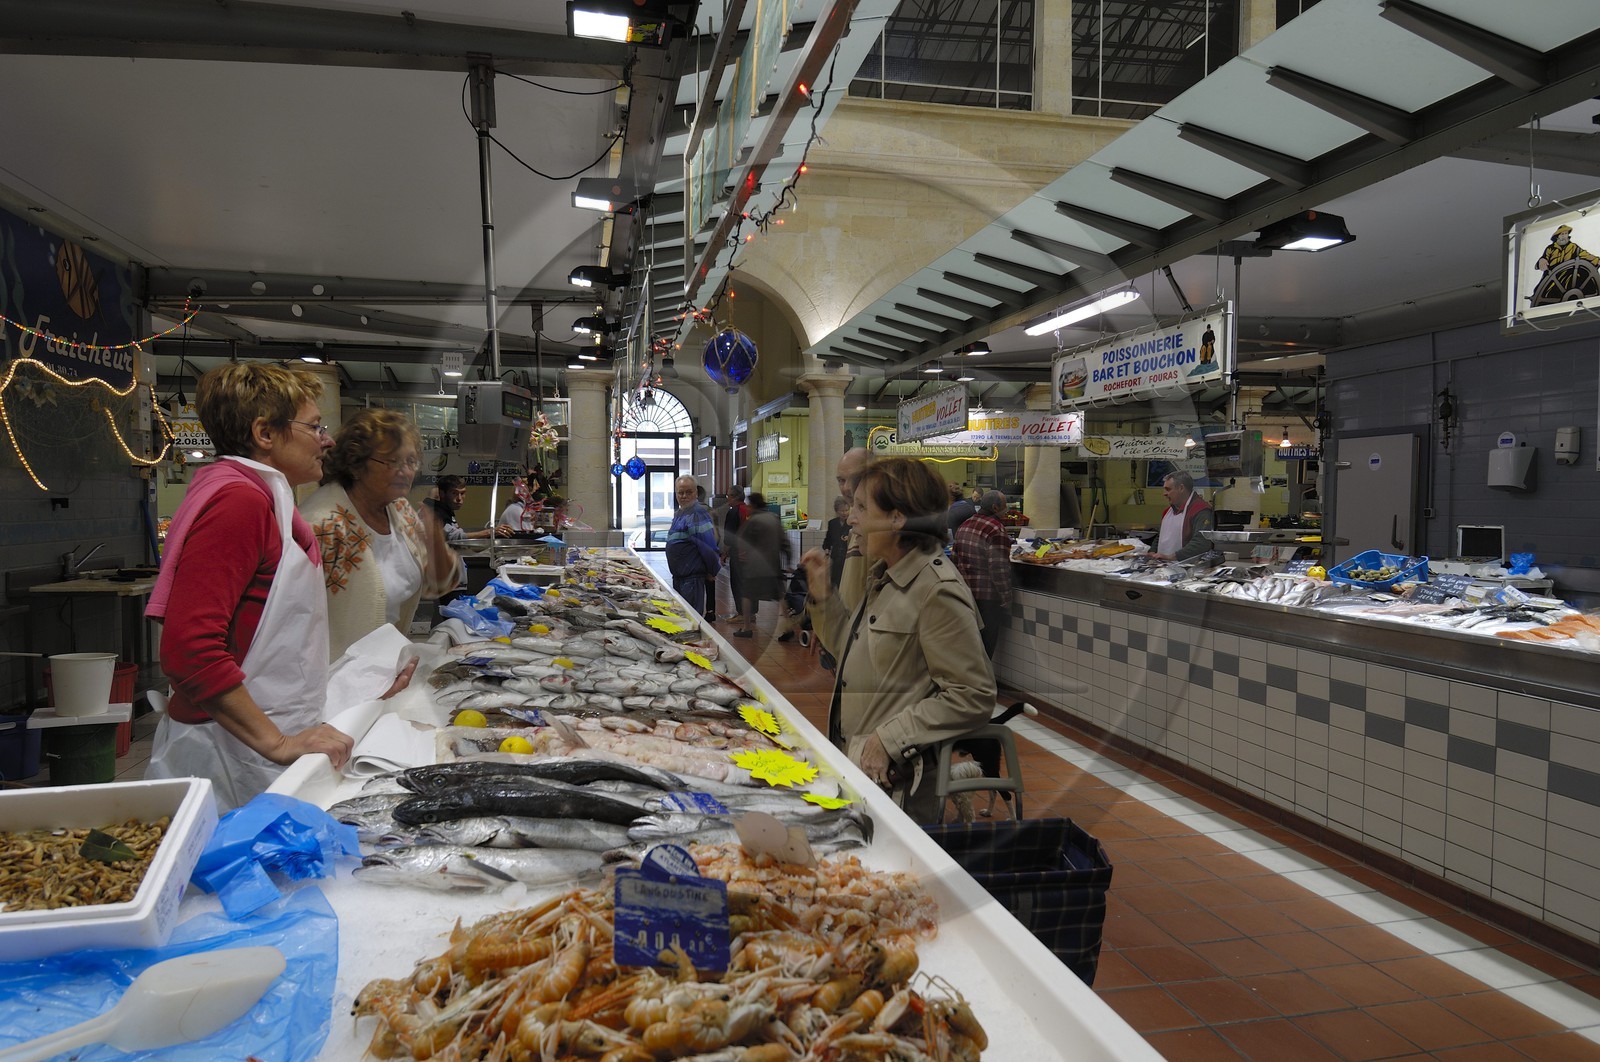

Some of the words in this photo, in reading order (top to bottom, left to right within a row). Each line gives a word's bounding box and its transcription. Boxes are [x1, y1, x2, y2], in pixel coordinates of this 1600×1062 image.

[19, 314, 134, 373] Fraicheur
[1102, 333, 1184, 365] POISSONNERIE
[1093, 366, 1114, 383] BAR
[1117, 362, 1131, 378] ET
[1133, 347, 1196, 375] BOUCHON
[1103, 376, 1142, 392] ROCHEFORT
[1148, 370, 1178, 384] FOURAS
[936, 397, 963, 421] VOLLET
[1021, 420, 1075, 435] VOLLET
